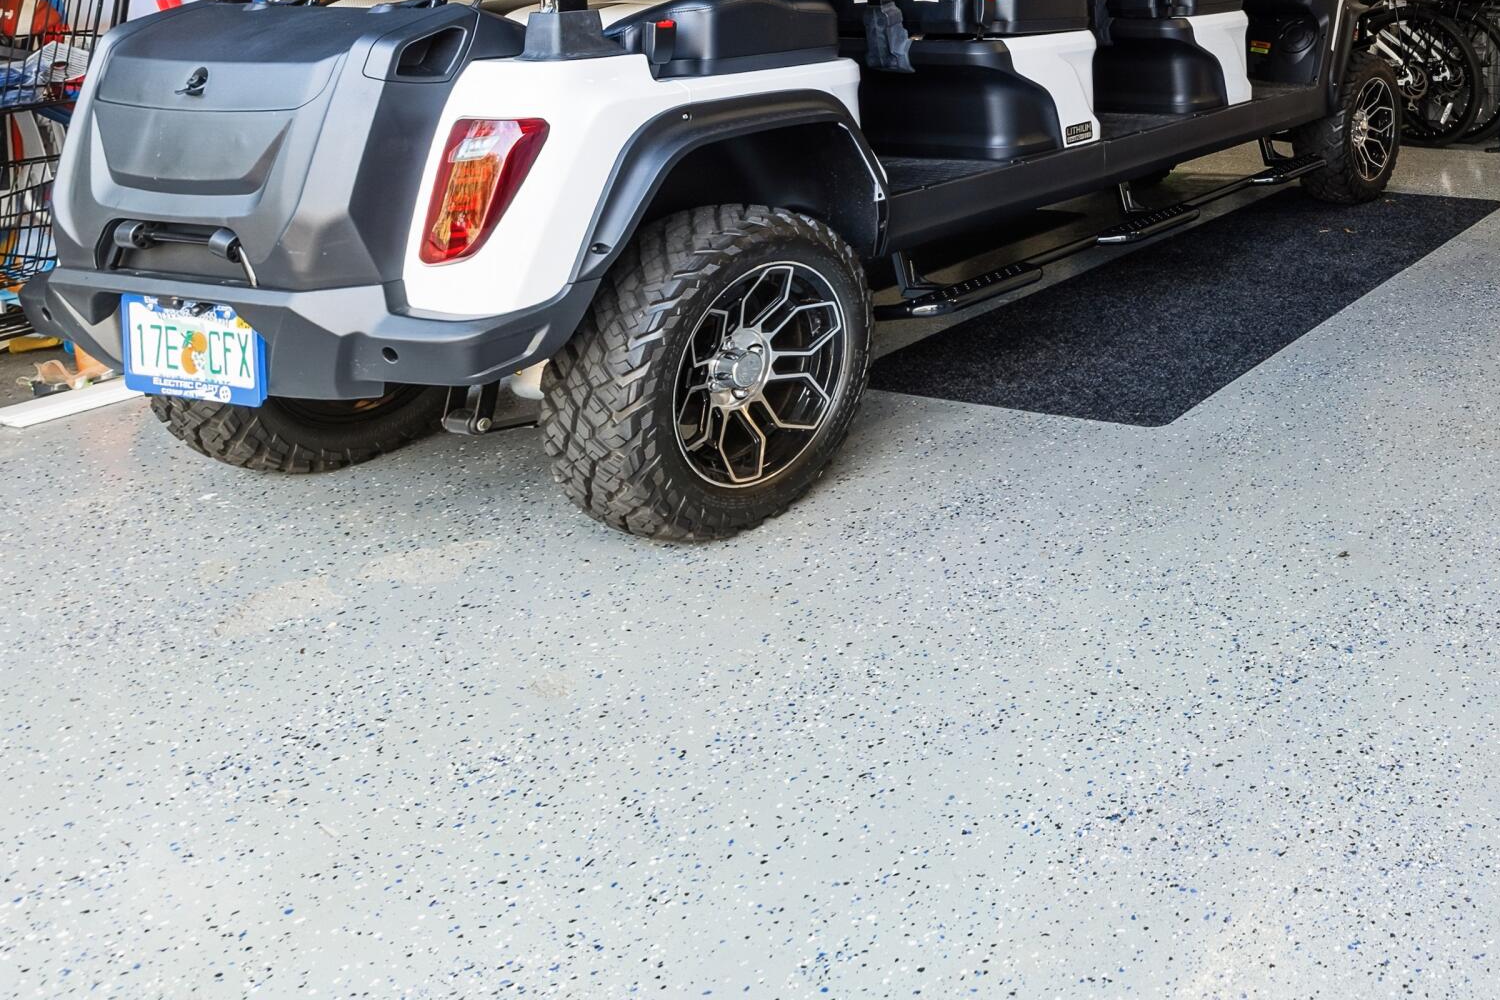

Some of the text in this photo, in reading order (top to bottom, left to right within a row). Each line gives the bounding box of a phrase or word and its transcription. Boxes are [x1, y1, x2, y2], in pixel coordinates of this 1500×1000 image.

[1066, 122, 1092, 137] LITHIUM
[137, 323, 251, 378] 17E CFX
[153, 377, 194, 389] ELECTRIC
